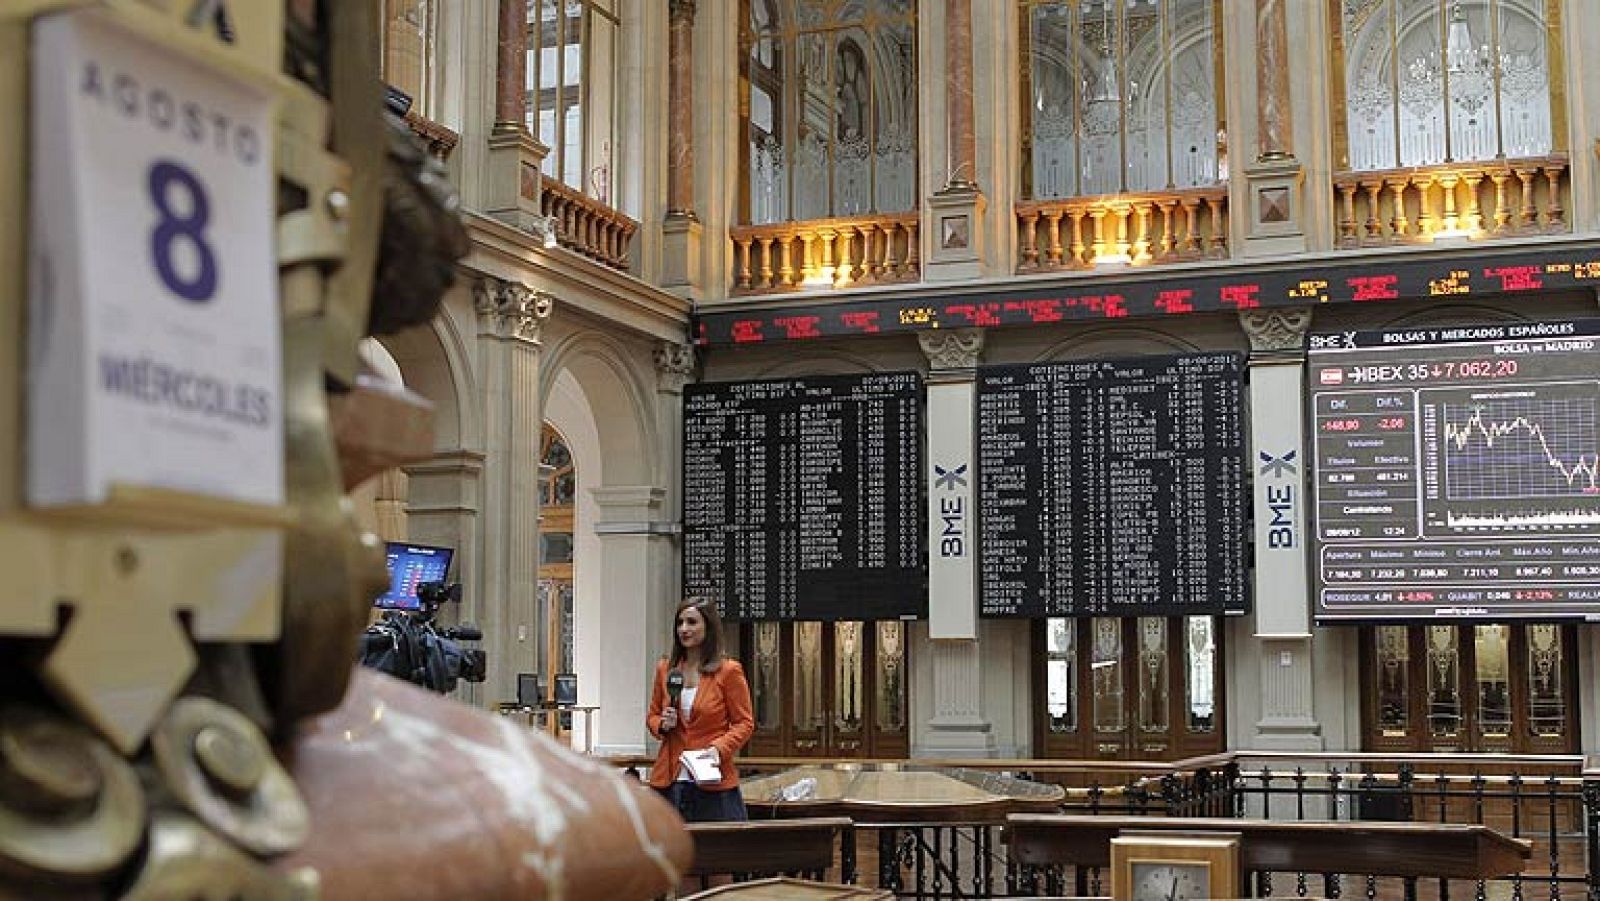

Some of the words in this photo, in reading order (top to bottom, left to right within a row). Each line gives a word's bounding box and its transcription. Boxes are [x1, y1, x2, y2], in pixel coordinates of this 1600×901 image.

[81, 61, 262, 166] AGOSTO
[145, 160, 219, 303] 8
[1382, 331, 1426, 343] BOLSAS
[1429, 331, 1439, 341] Y
[1441, 326, 1505, 340] MERCADOS
[1508, 322, 1574, 337] ESPAÑOLES
[1493, 343, 1530, 353] BOLSA
[1545, 340, 1594, 351] MADRID
[1407, 364, 1429, 380] 35
[1446, 360, 1518, 378] 7.062,20
[941, 496, 962, 557] BME
[1268, 485, 1292, 549] BME
